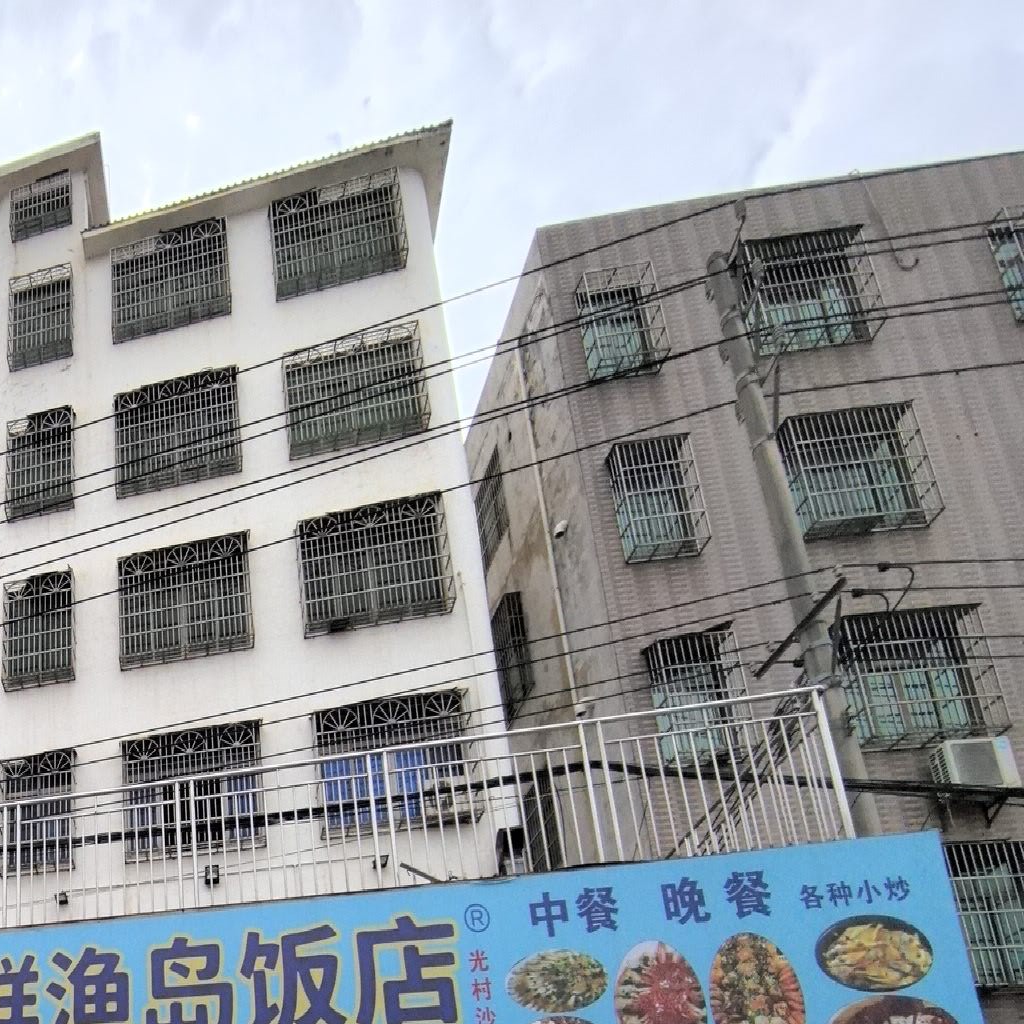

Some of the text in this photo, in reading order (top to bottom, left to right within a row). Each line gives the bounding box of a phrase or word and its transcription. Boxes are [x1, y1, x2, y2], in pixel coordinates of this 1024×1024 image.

[530, 872, 772, 939] 中餐 晚餐
[799, 876, 911, 910] 各种小炒
